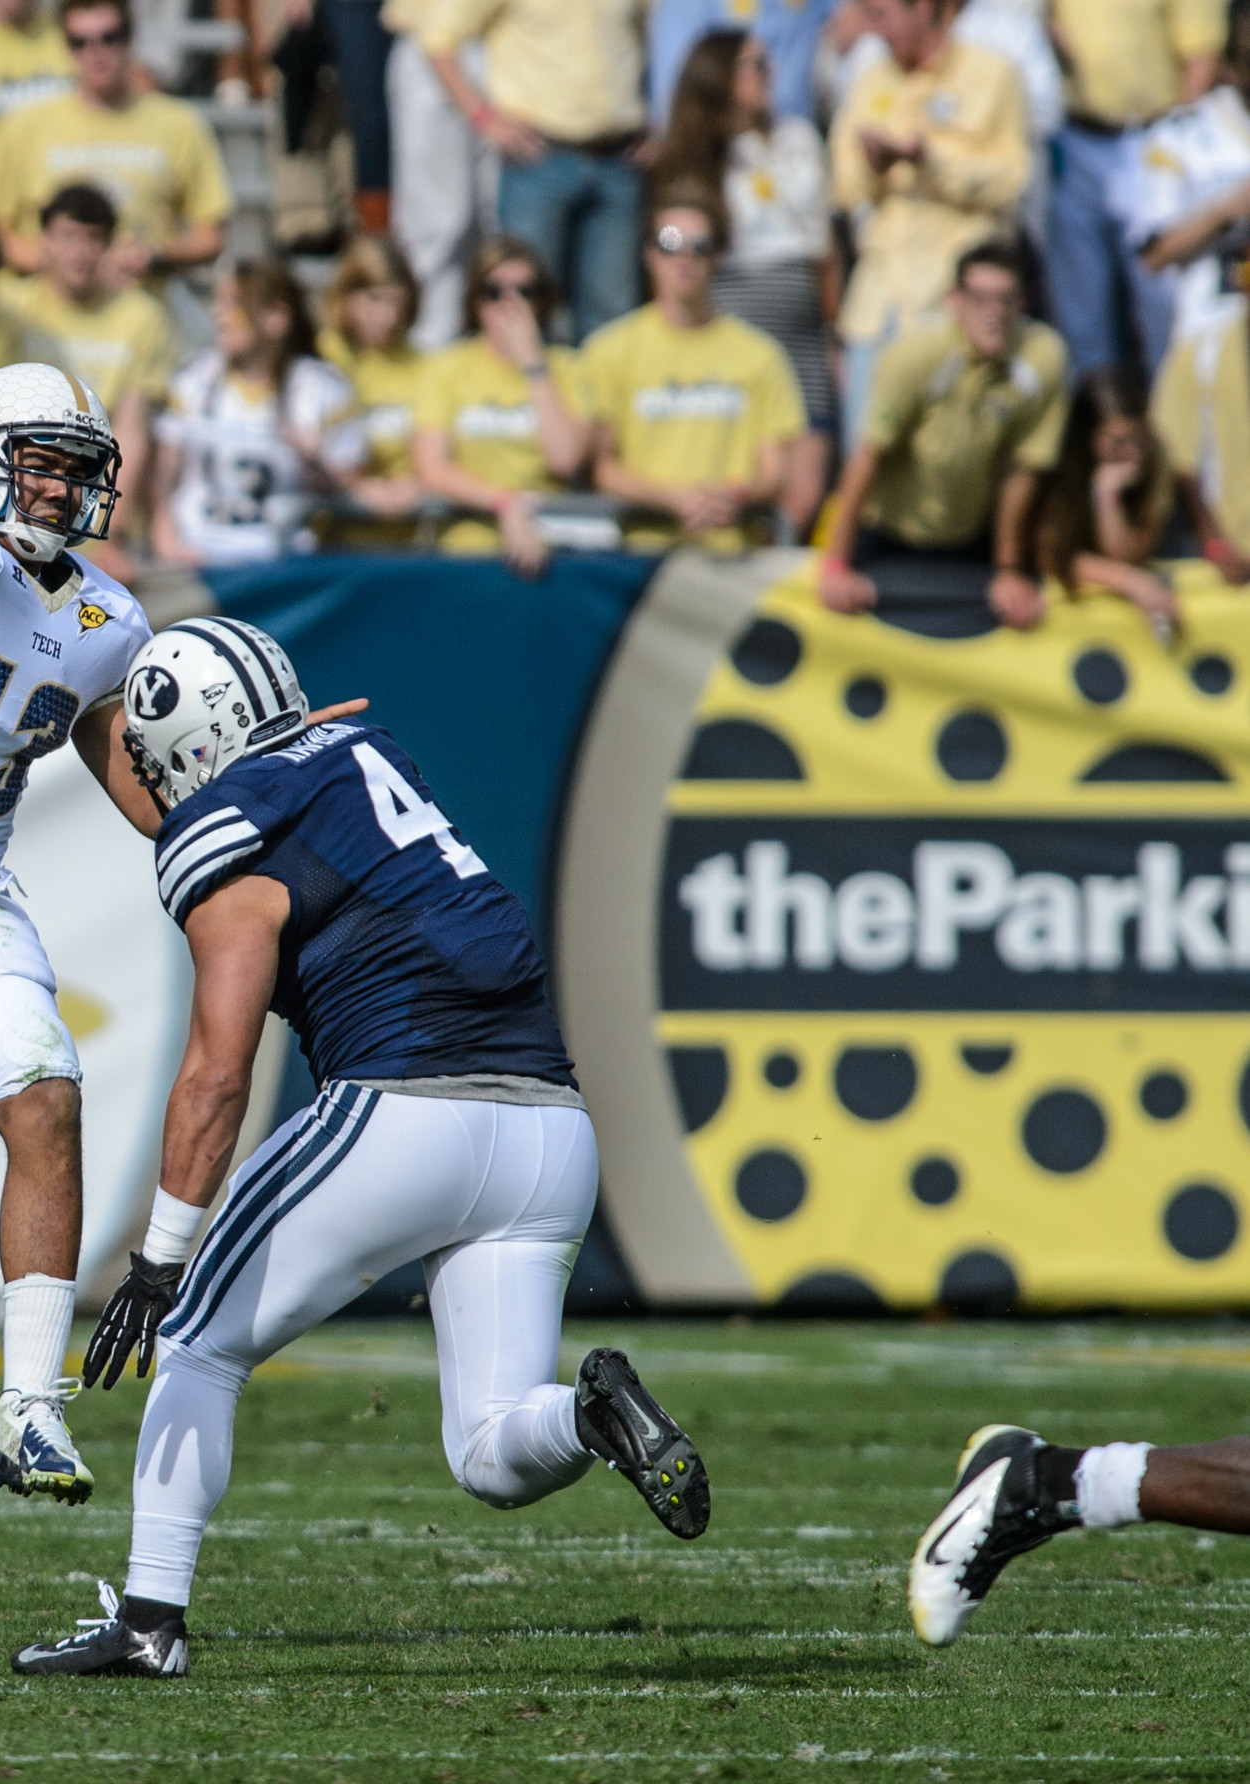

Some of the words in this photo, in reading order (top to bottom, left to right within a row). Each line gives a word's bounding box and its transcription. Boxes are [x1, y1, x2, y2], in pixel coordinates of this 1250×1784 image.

[75, 412, 96, 426] ACC
[81, 609, 104, 625] ACC
[31, 631, 63, 660] TECH
[351, 741, 489, 881] 4
